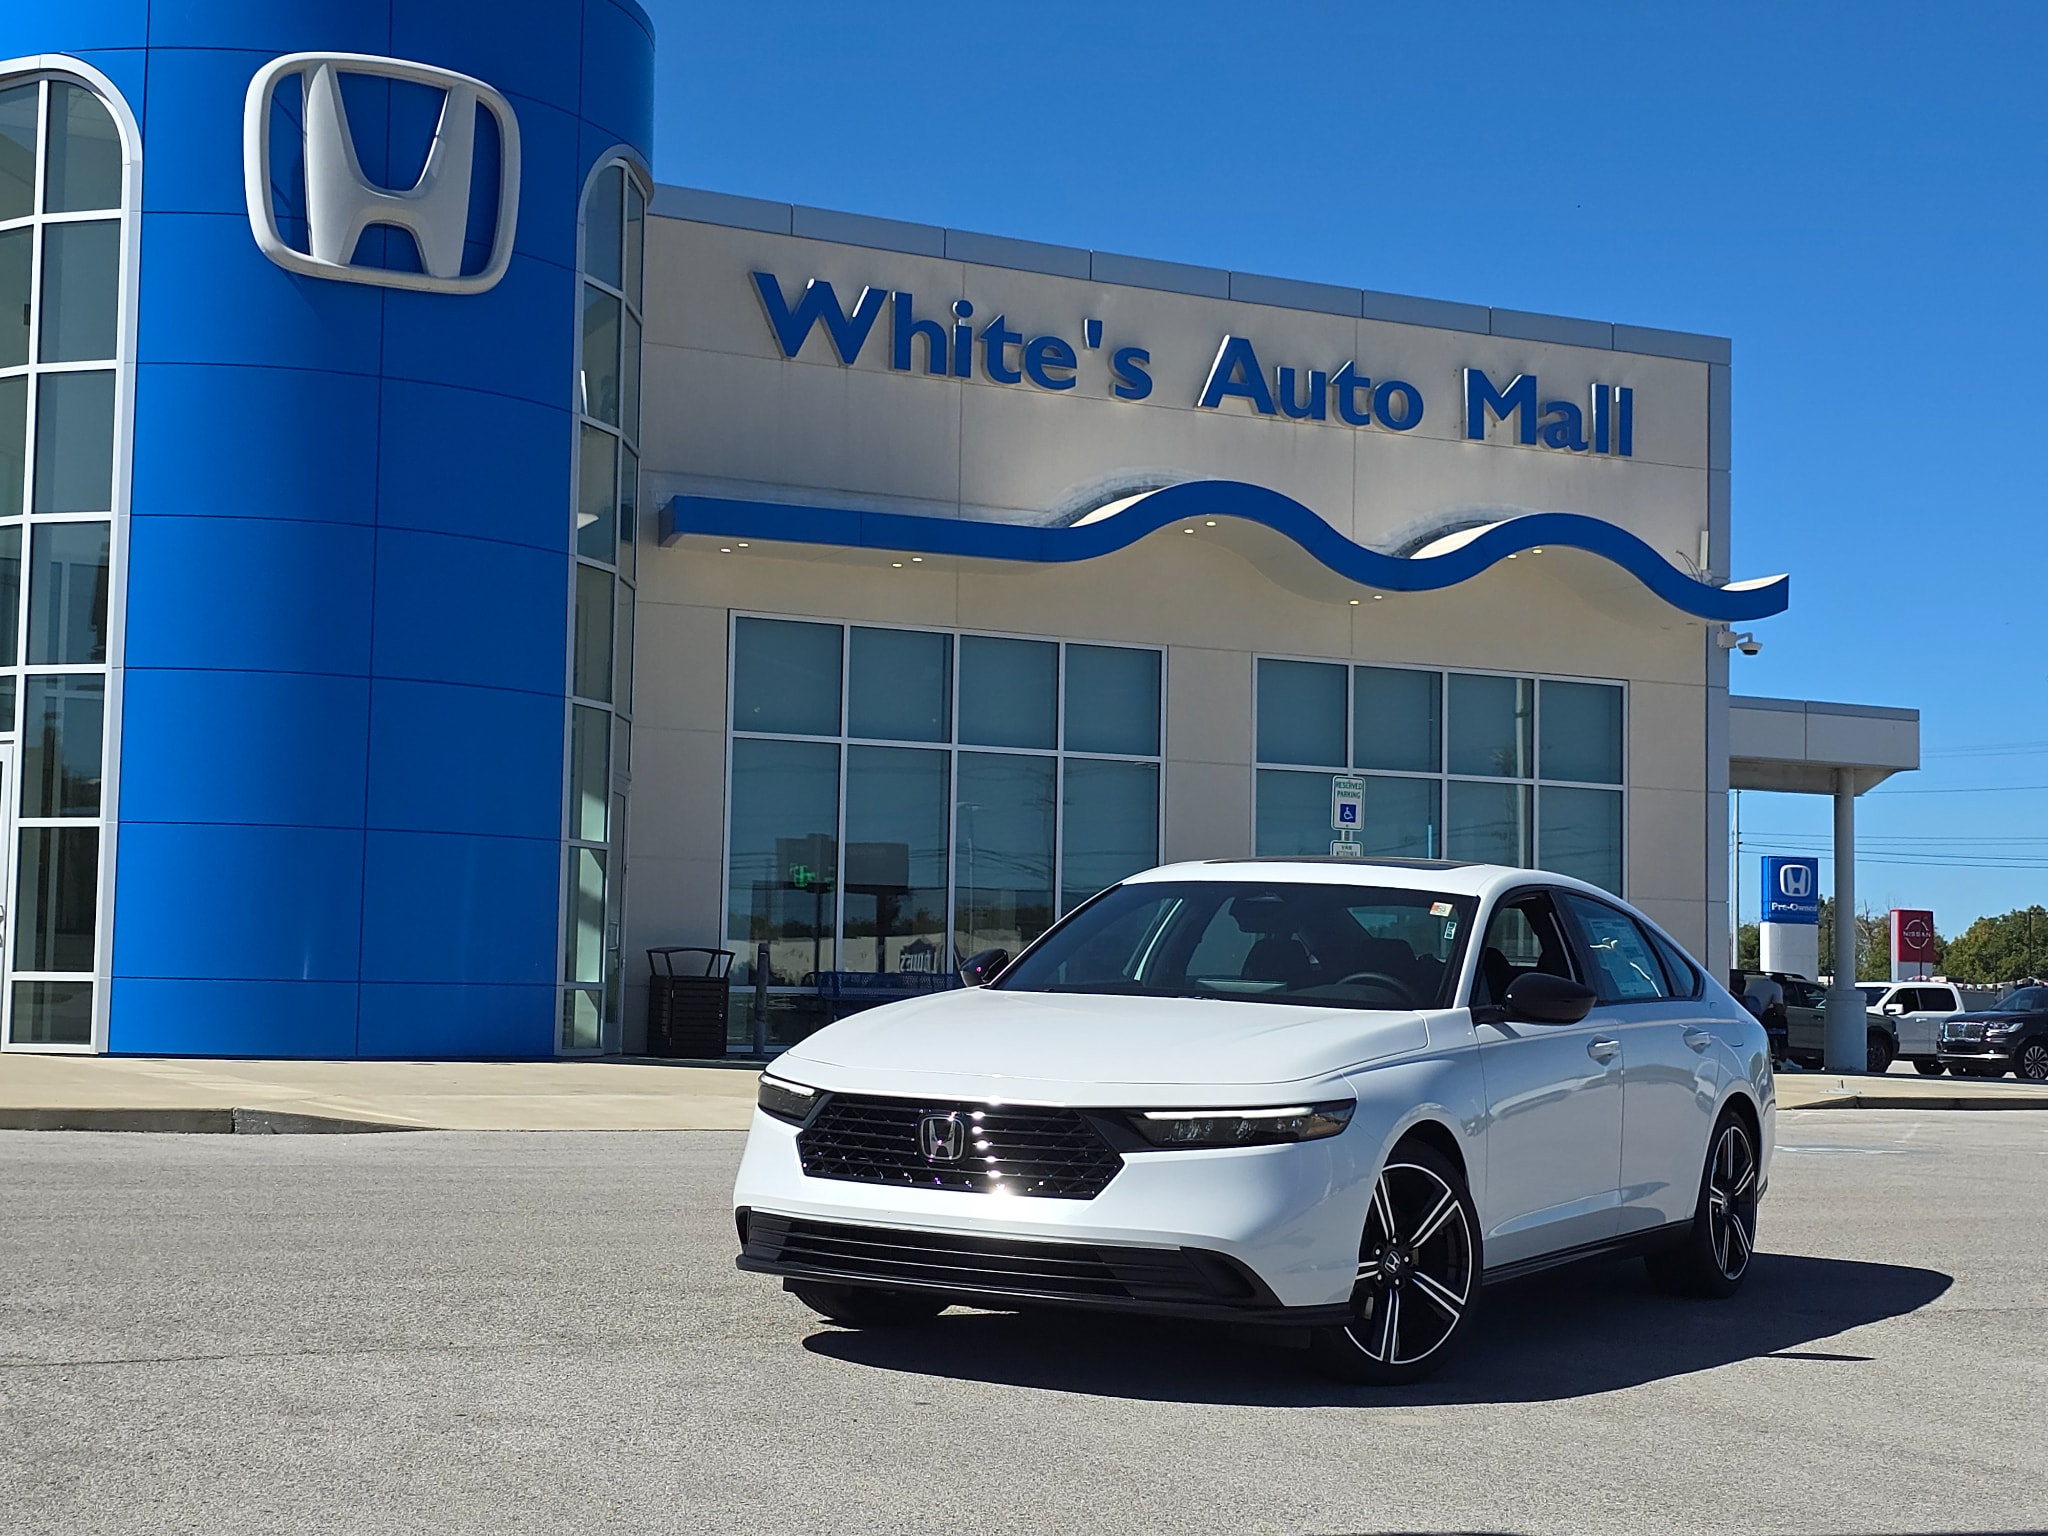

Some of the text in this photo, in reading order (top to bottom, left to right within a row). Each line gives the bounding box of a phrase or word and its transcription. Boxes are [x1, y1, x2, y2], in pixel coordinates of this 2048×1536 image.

[751, 271, 1634, 457] White's Auto Mall
[1335, 781, 1363, 790] RESERVED
[1336, 790, 1361, 799] PARKING
[1902, 930, 1931, 938] NISSAN
